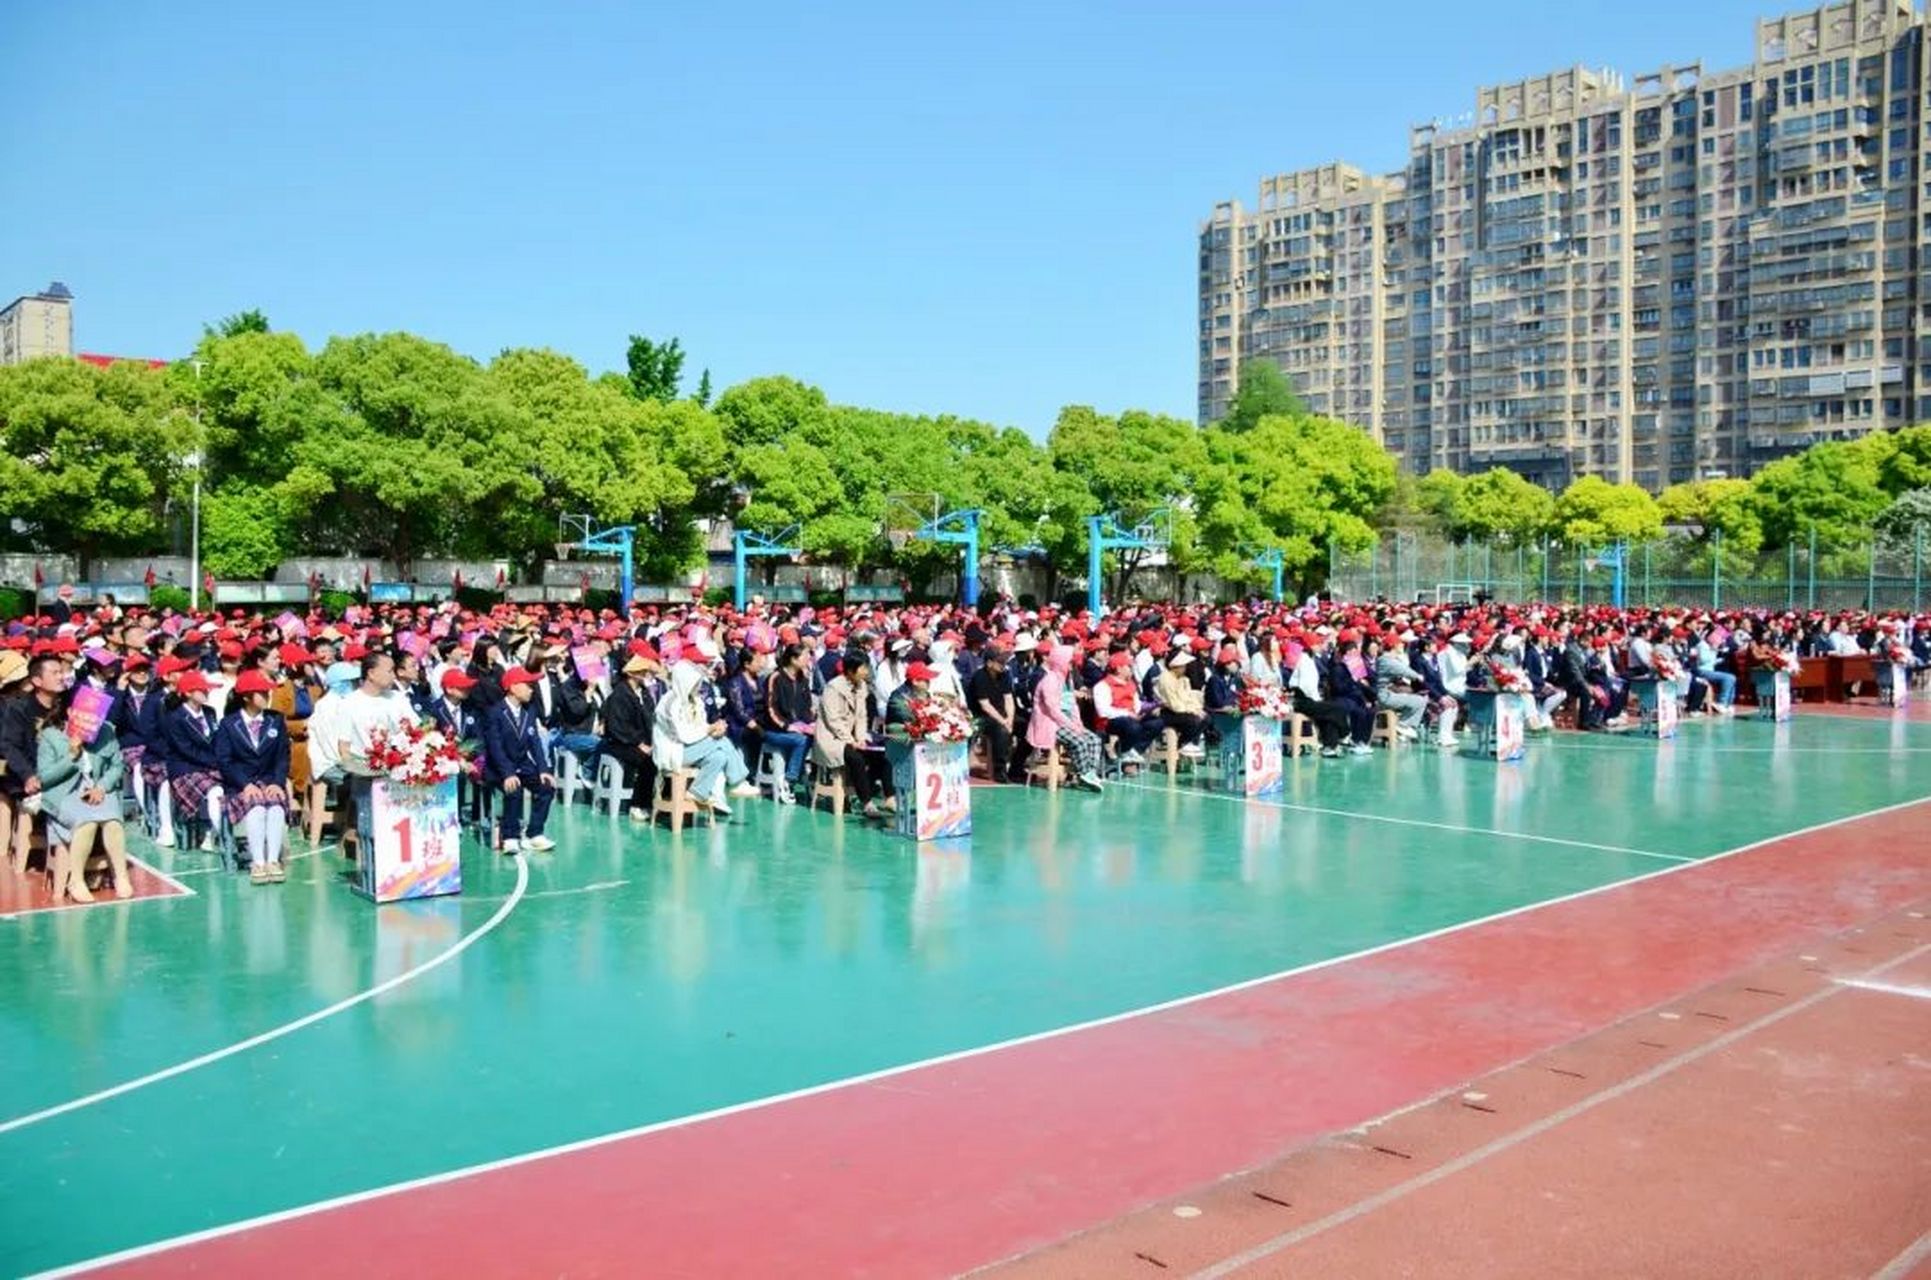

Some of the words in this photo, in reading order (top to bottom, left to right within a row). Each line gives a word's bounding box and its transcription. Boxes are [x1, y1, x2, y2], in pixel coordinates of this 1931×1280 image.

[1252, 741, 1263, 771] 3
[926, 772, 943, 810] 2
[392, 817, 412, 863] 1
[422, 837, 443, 859] 班
